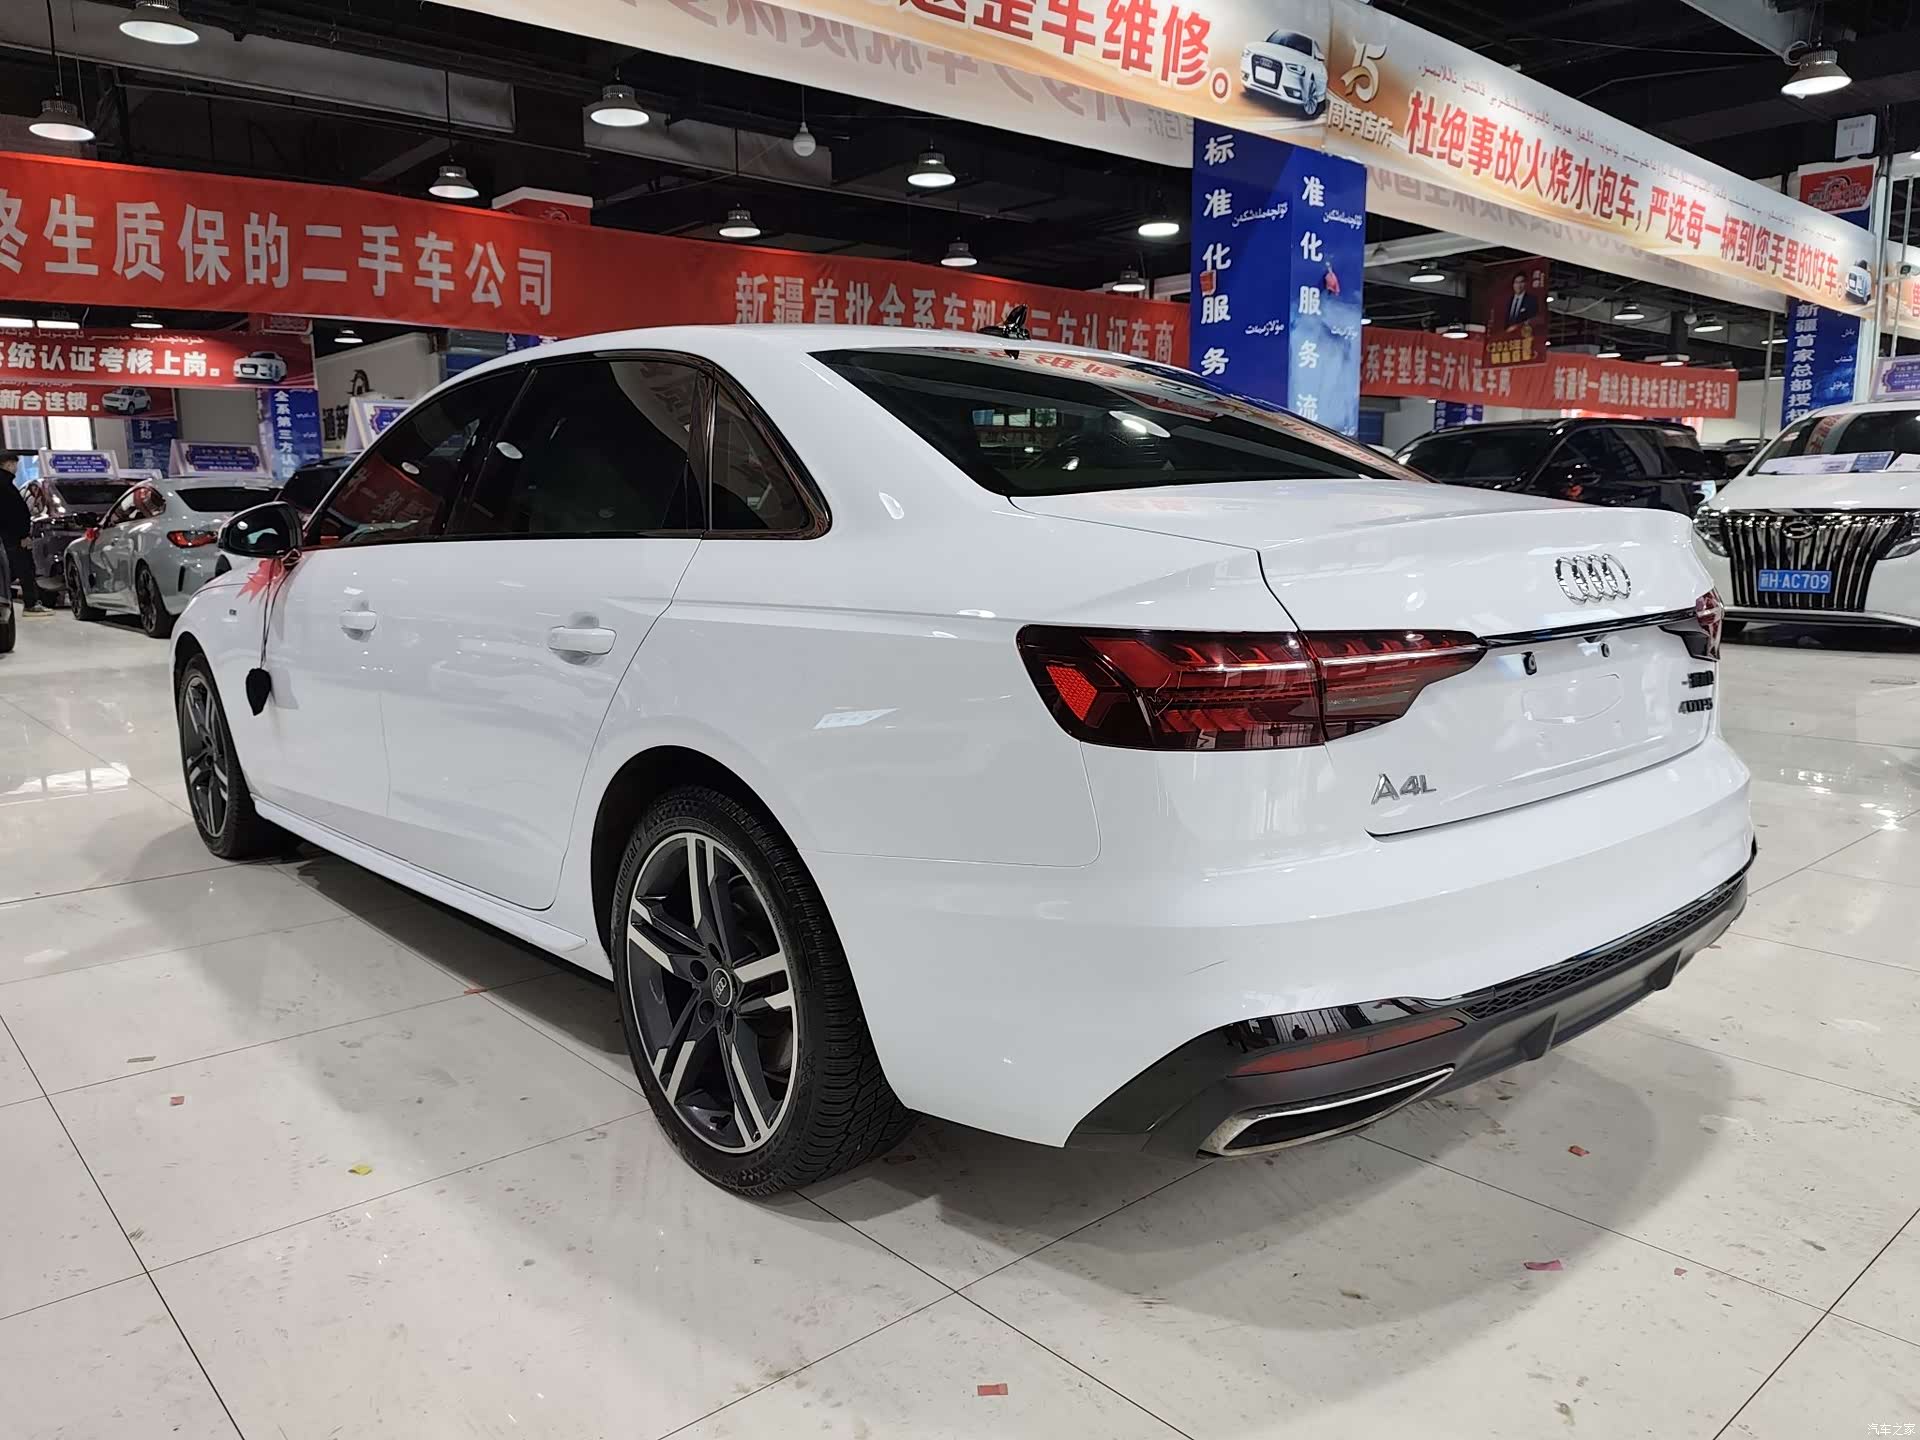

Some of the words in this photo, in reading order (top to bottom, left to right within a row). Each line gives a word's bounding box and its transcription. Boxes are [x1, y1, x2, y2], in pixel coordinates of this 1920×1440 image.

[900, 0, 1228, 98] 车维修。
[1201, 134, 1235, 376] 标准化服务
[0, 341, 220, 377] 统认证考核上岗。
[1371, 772, 1437, 805] A4L
